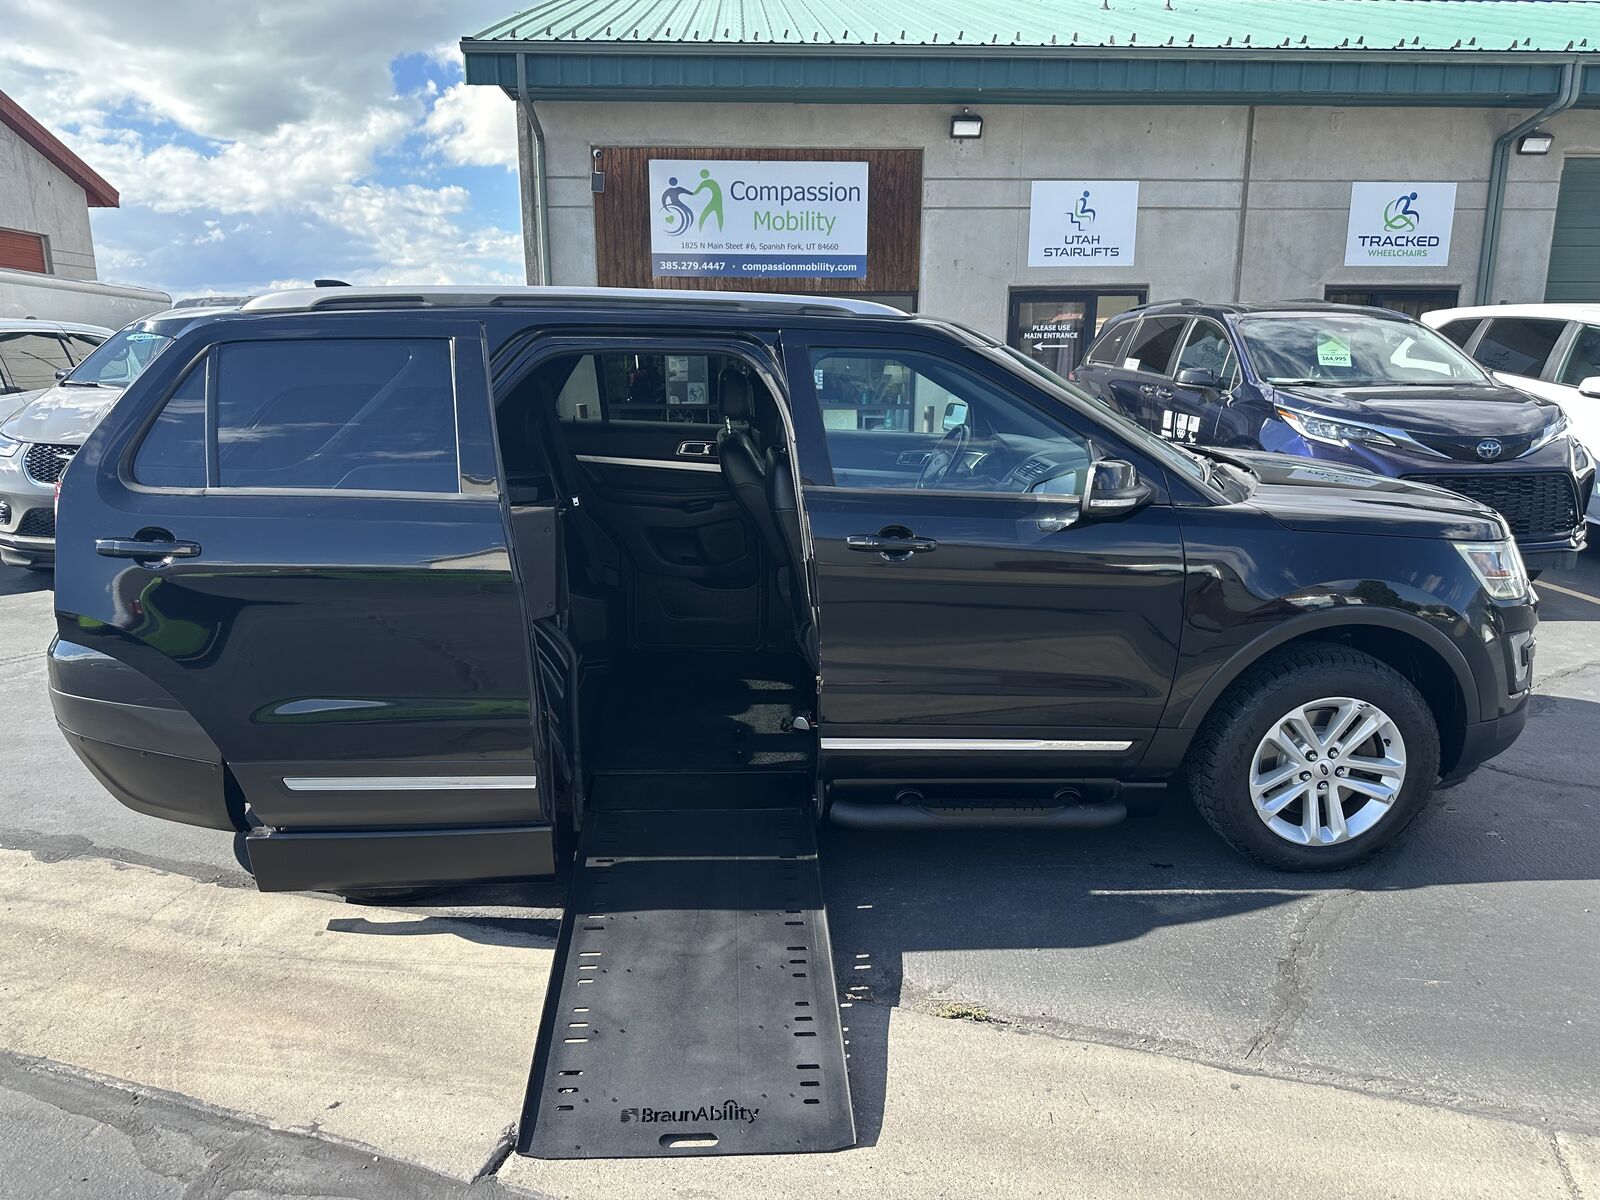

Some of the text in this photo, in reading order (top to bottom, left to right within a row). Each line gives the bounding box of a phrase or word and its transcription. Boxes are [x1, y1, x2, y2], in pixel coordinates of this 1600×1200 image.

[730, 180, 860, 206] Compassion
[753, 210, 836, 236] Mobility
[1064, 235, 1100, 245] UTAH
[1358, 235, 1440, 247] TRACKED
[707, 242, 724, 250] Main
[745, 243, 757, 252] #6,
[759, 243, 786, 252] Spanish
[787, 243, 804, 252] Fork,
[1043, 247, 1120, 257] STAIRLIFTS
[1368, 249, 1428, 257] WHEELCHAIRS
[660, 261, 857, 273] 385.279.4447 compassionmobility.com
[1032, 324, 1057, 332] PLEASE
[641, 1099, 760, 1124] BraunAbility
